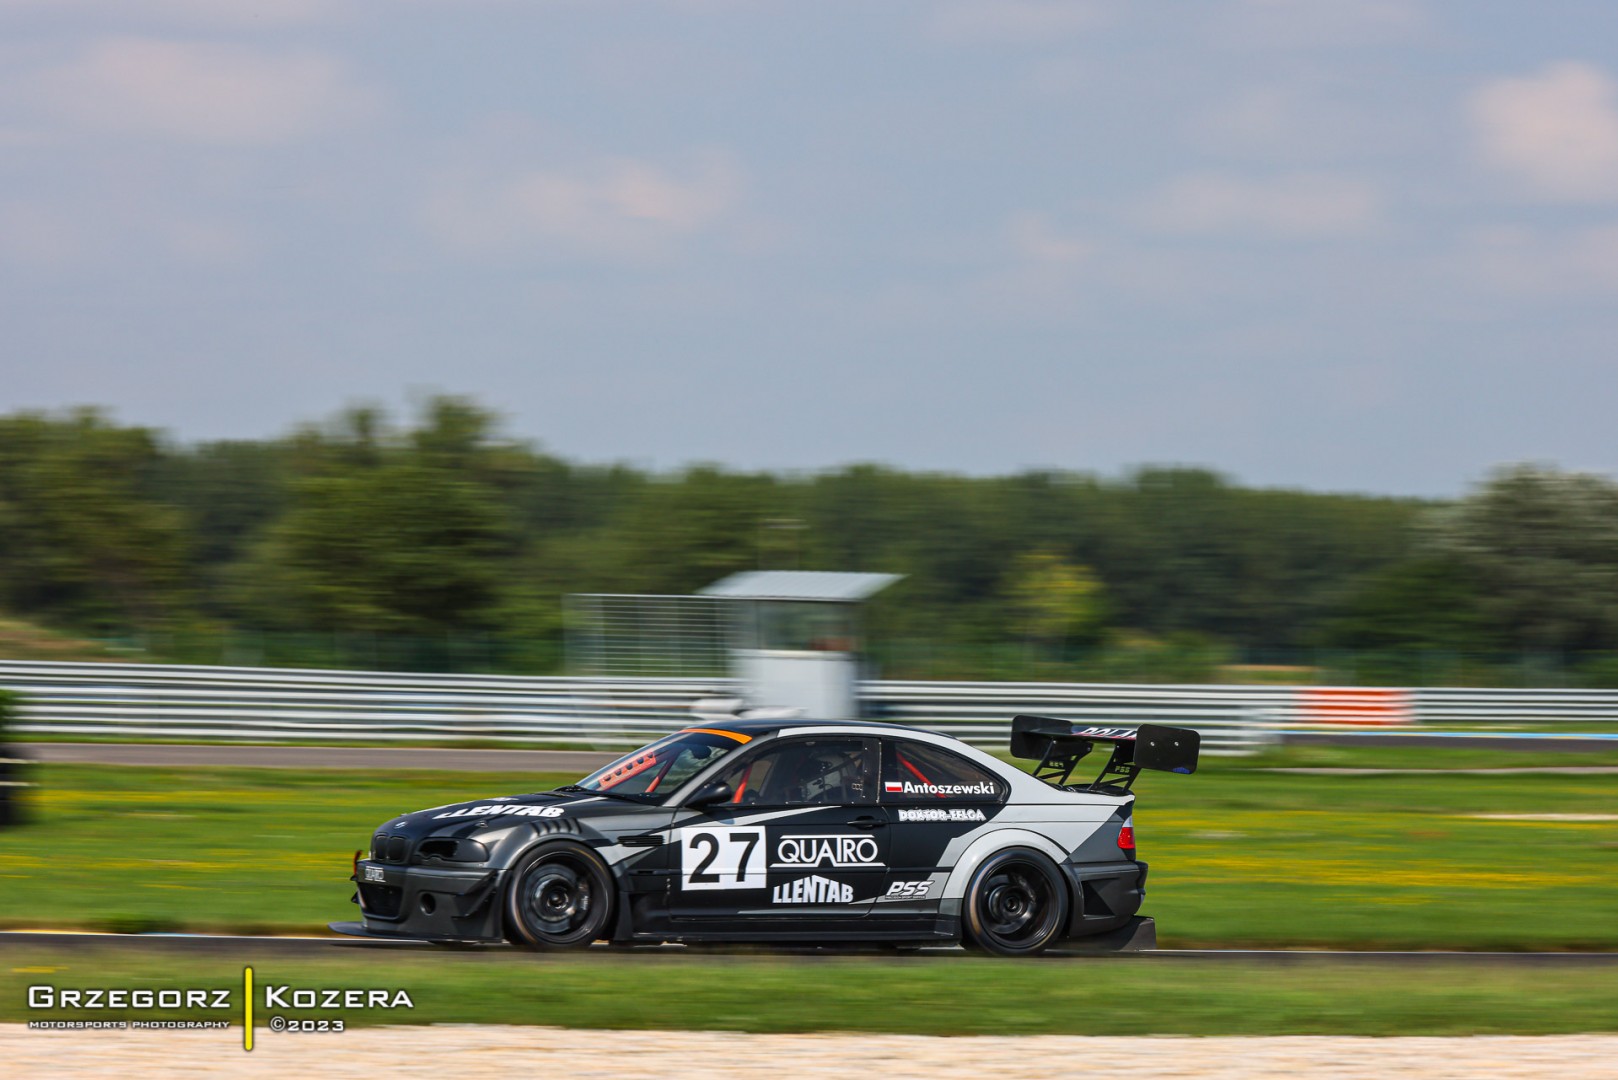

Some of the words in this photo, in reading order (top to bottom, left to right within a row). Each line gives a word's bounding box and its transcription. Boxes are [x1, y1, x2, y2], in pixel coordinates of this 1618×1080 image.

[1114, 765, 1131, 774] PSS
[903, 781, 995, 795] Antoszewski
[688, 832, 760, 884] 27
[775, 835, 880, 866] QUATRO
[772, 874, 854, 904] LLENTAB
[886, 881, 934, 896] PSS
